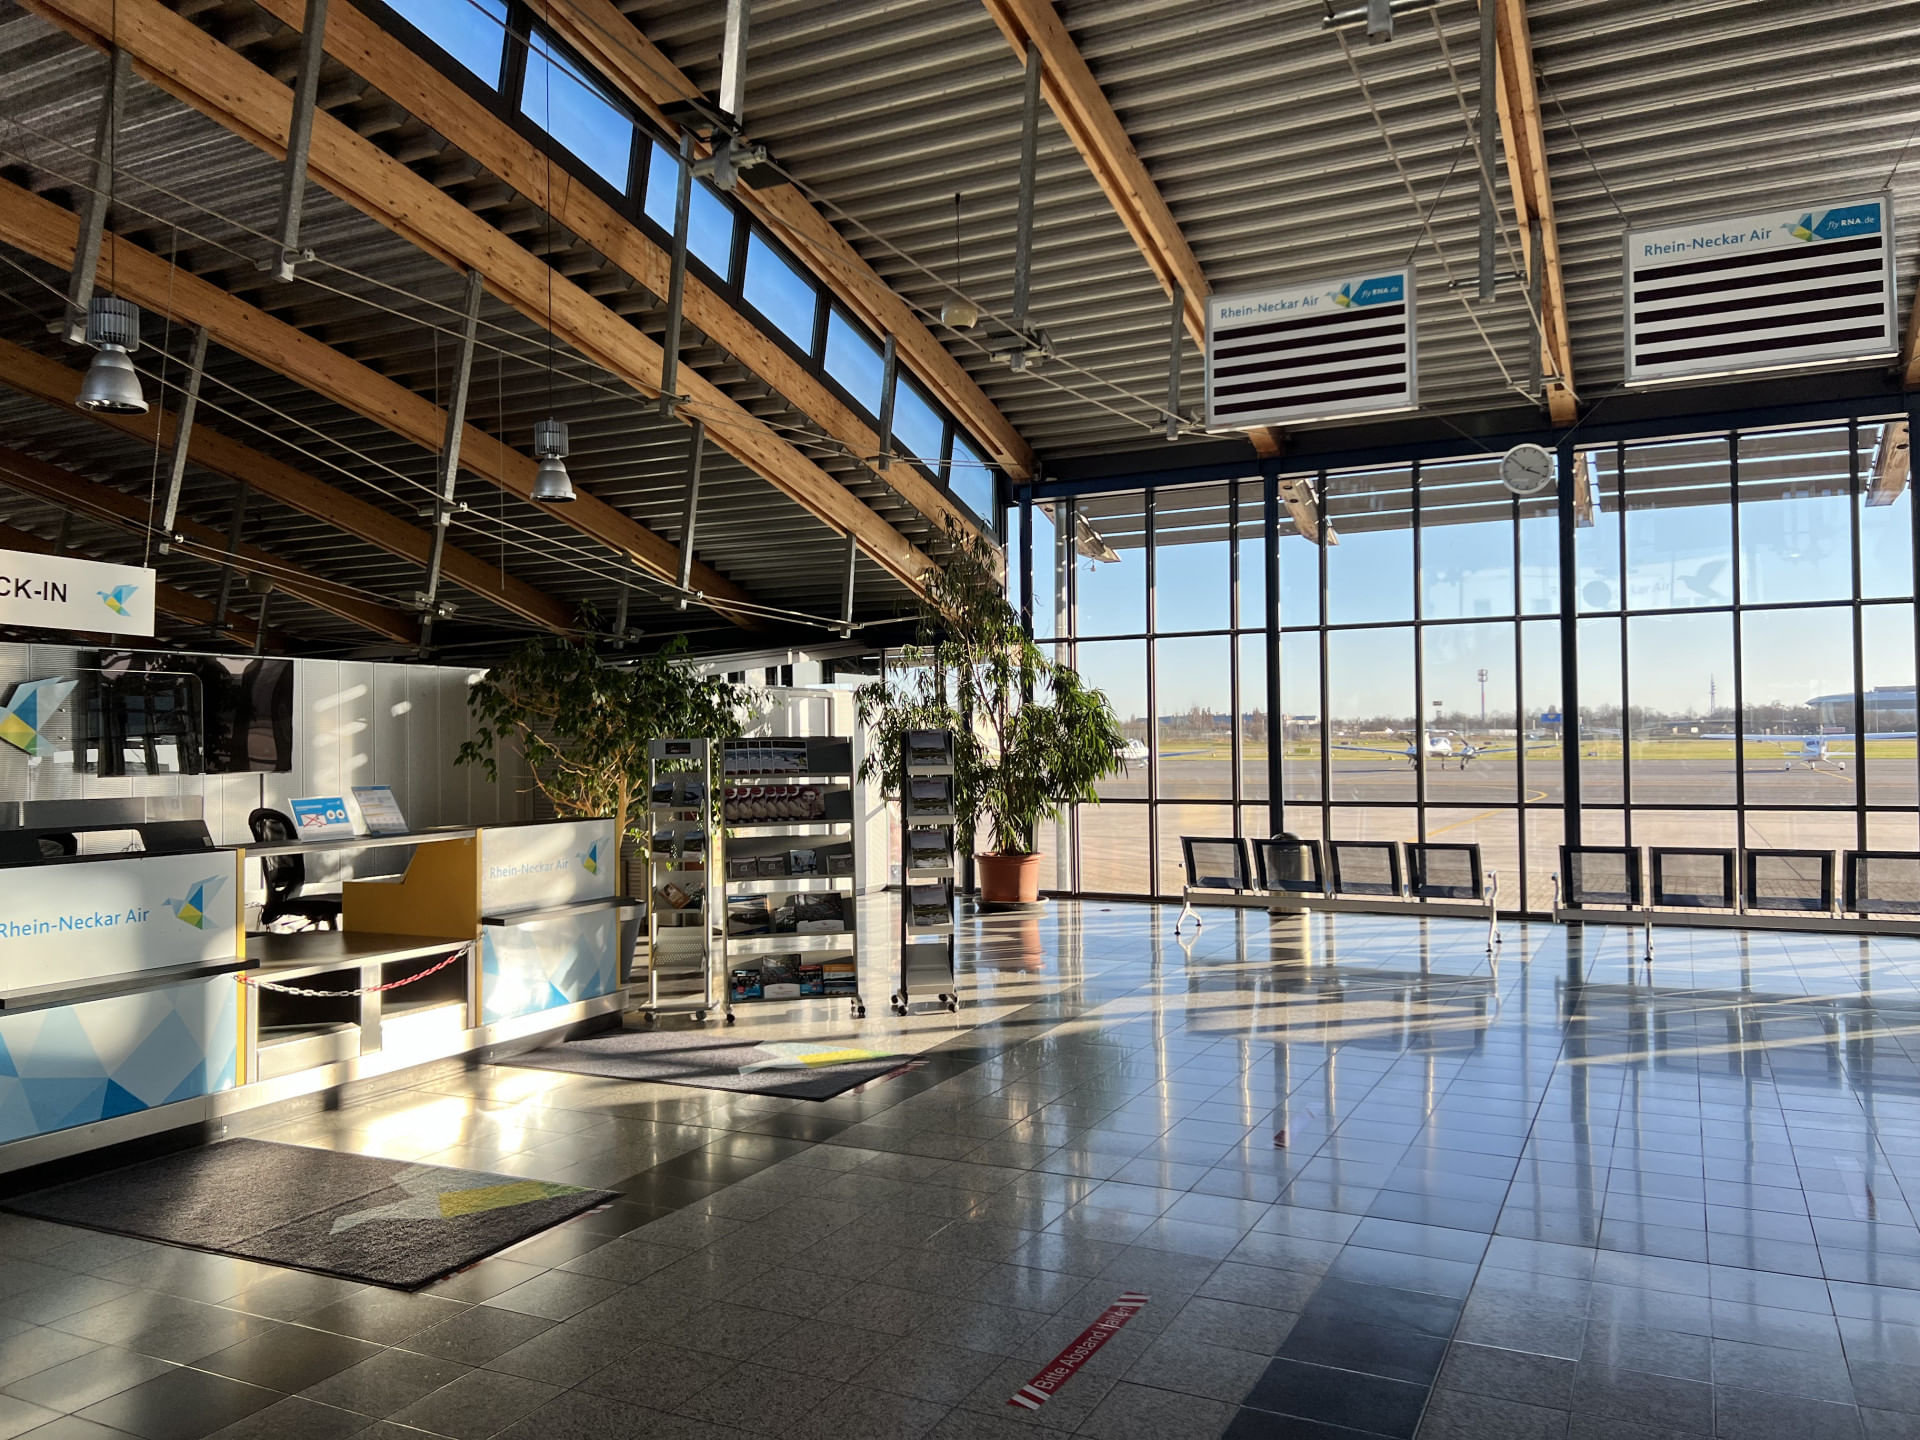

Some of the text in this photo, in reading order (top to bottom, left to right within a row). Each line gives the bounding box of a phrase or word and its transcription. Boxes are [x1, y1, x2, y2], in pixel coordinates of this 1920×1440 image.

[1644, 228, 1772, 257] Rhein-Neckar Air
[1220, 295, 1320, 319] Rhein-Neckar Air
[0, 576, 68, 603] CK-IN
[490, 857, 569, 879] Rhein-Neckar Air
[0, 907, 150, 938] Rhein-Neckar Air
[1033, 1367, 1070, 1390] Bitte
[1060, 1330, 1107, 1368] Abstand
